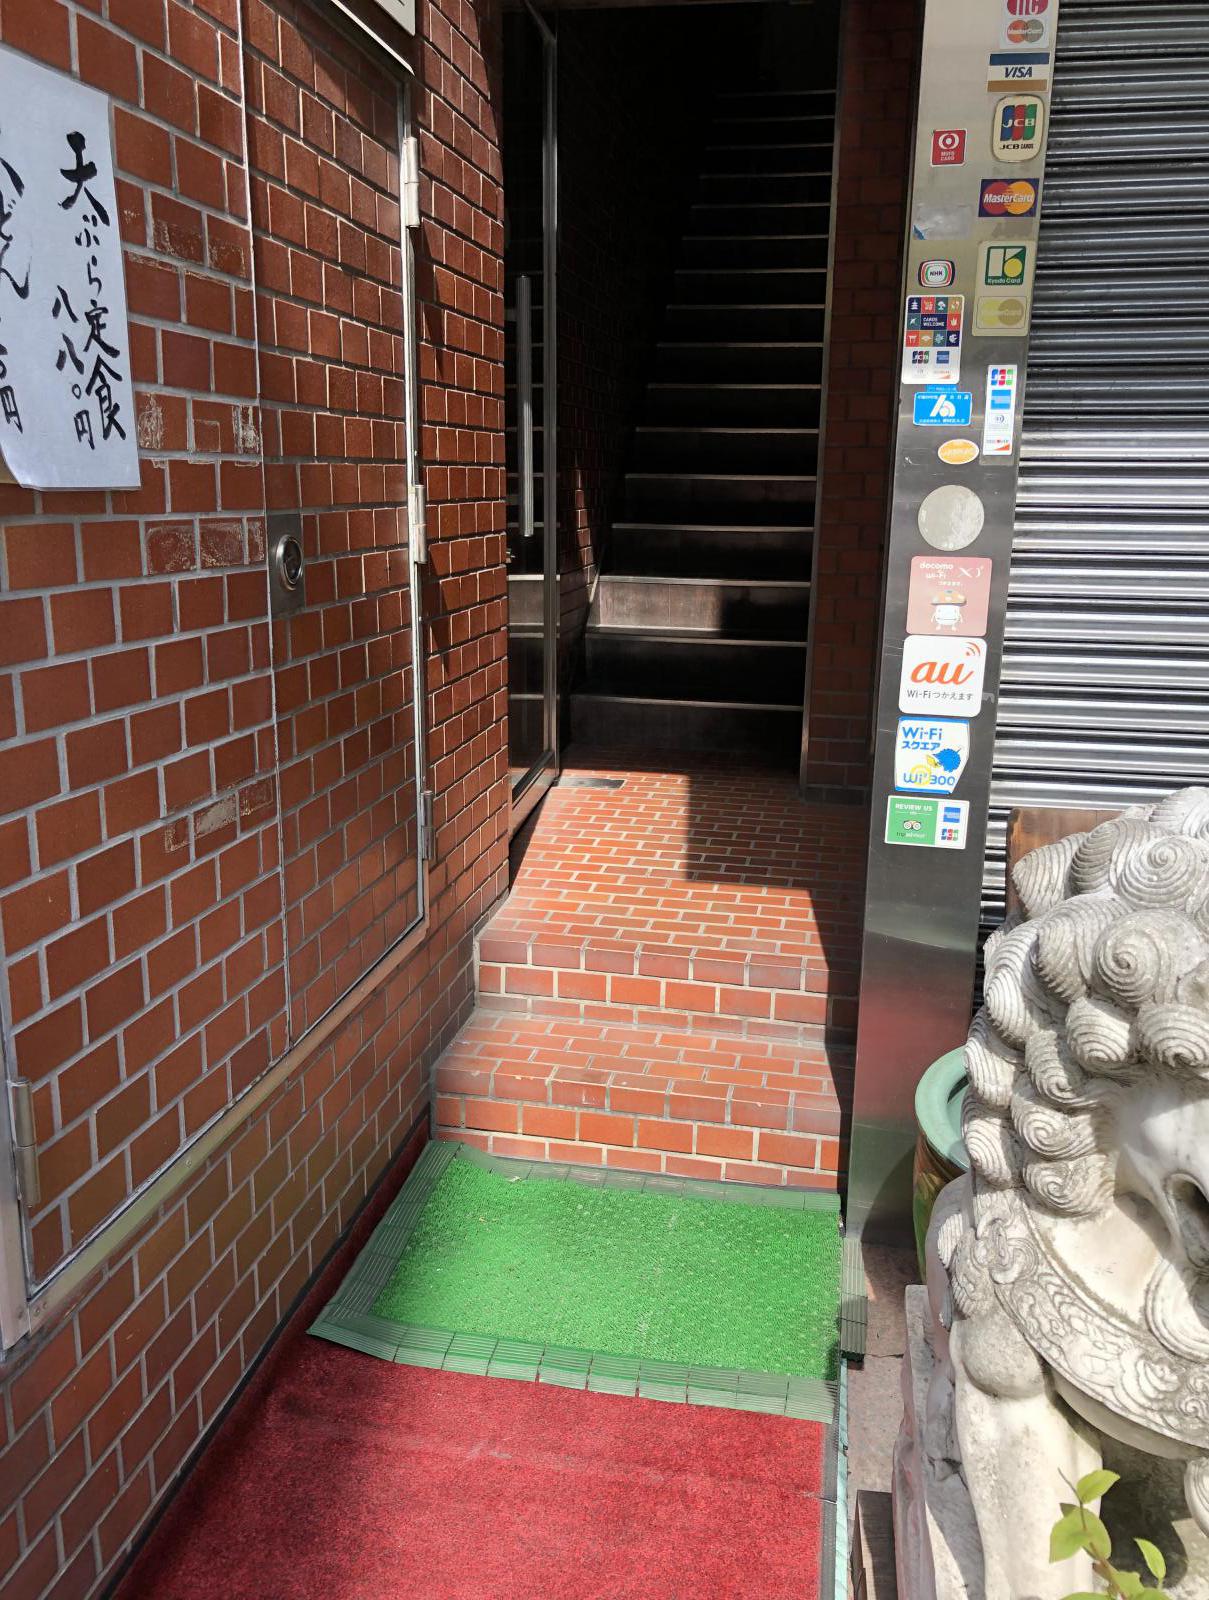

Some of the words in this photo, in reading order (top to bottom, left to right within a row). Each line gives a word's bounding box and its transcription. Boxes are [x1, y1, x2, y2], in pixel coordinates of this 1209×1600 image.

[1004, 66, 1033, 78] VISA
[1002, 119, 1036, 128] JCB
[983, 193, 1034, 204] MasterCard
[919, 561, 954, 570] docomo
[911, 661, 975, 685] au
[902, 726, 943, 740] Wi-Fi
[901, 740, 941, 751] スクエア
[895, 803, 922, 811] REVIEW
